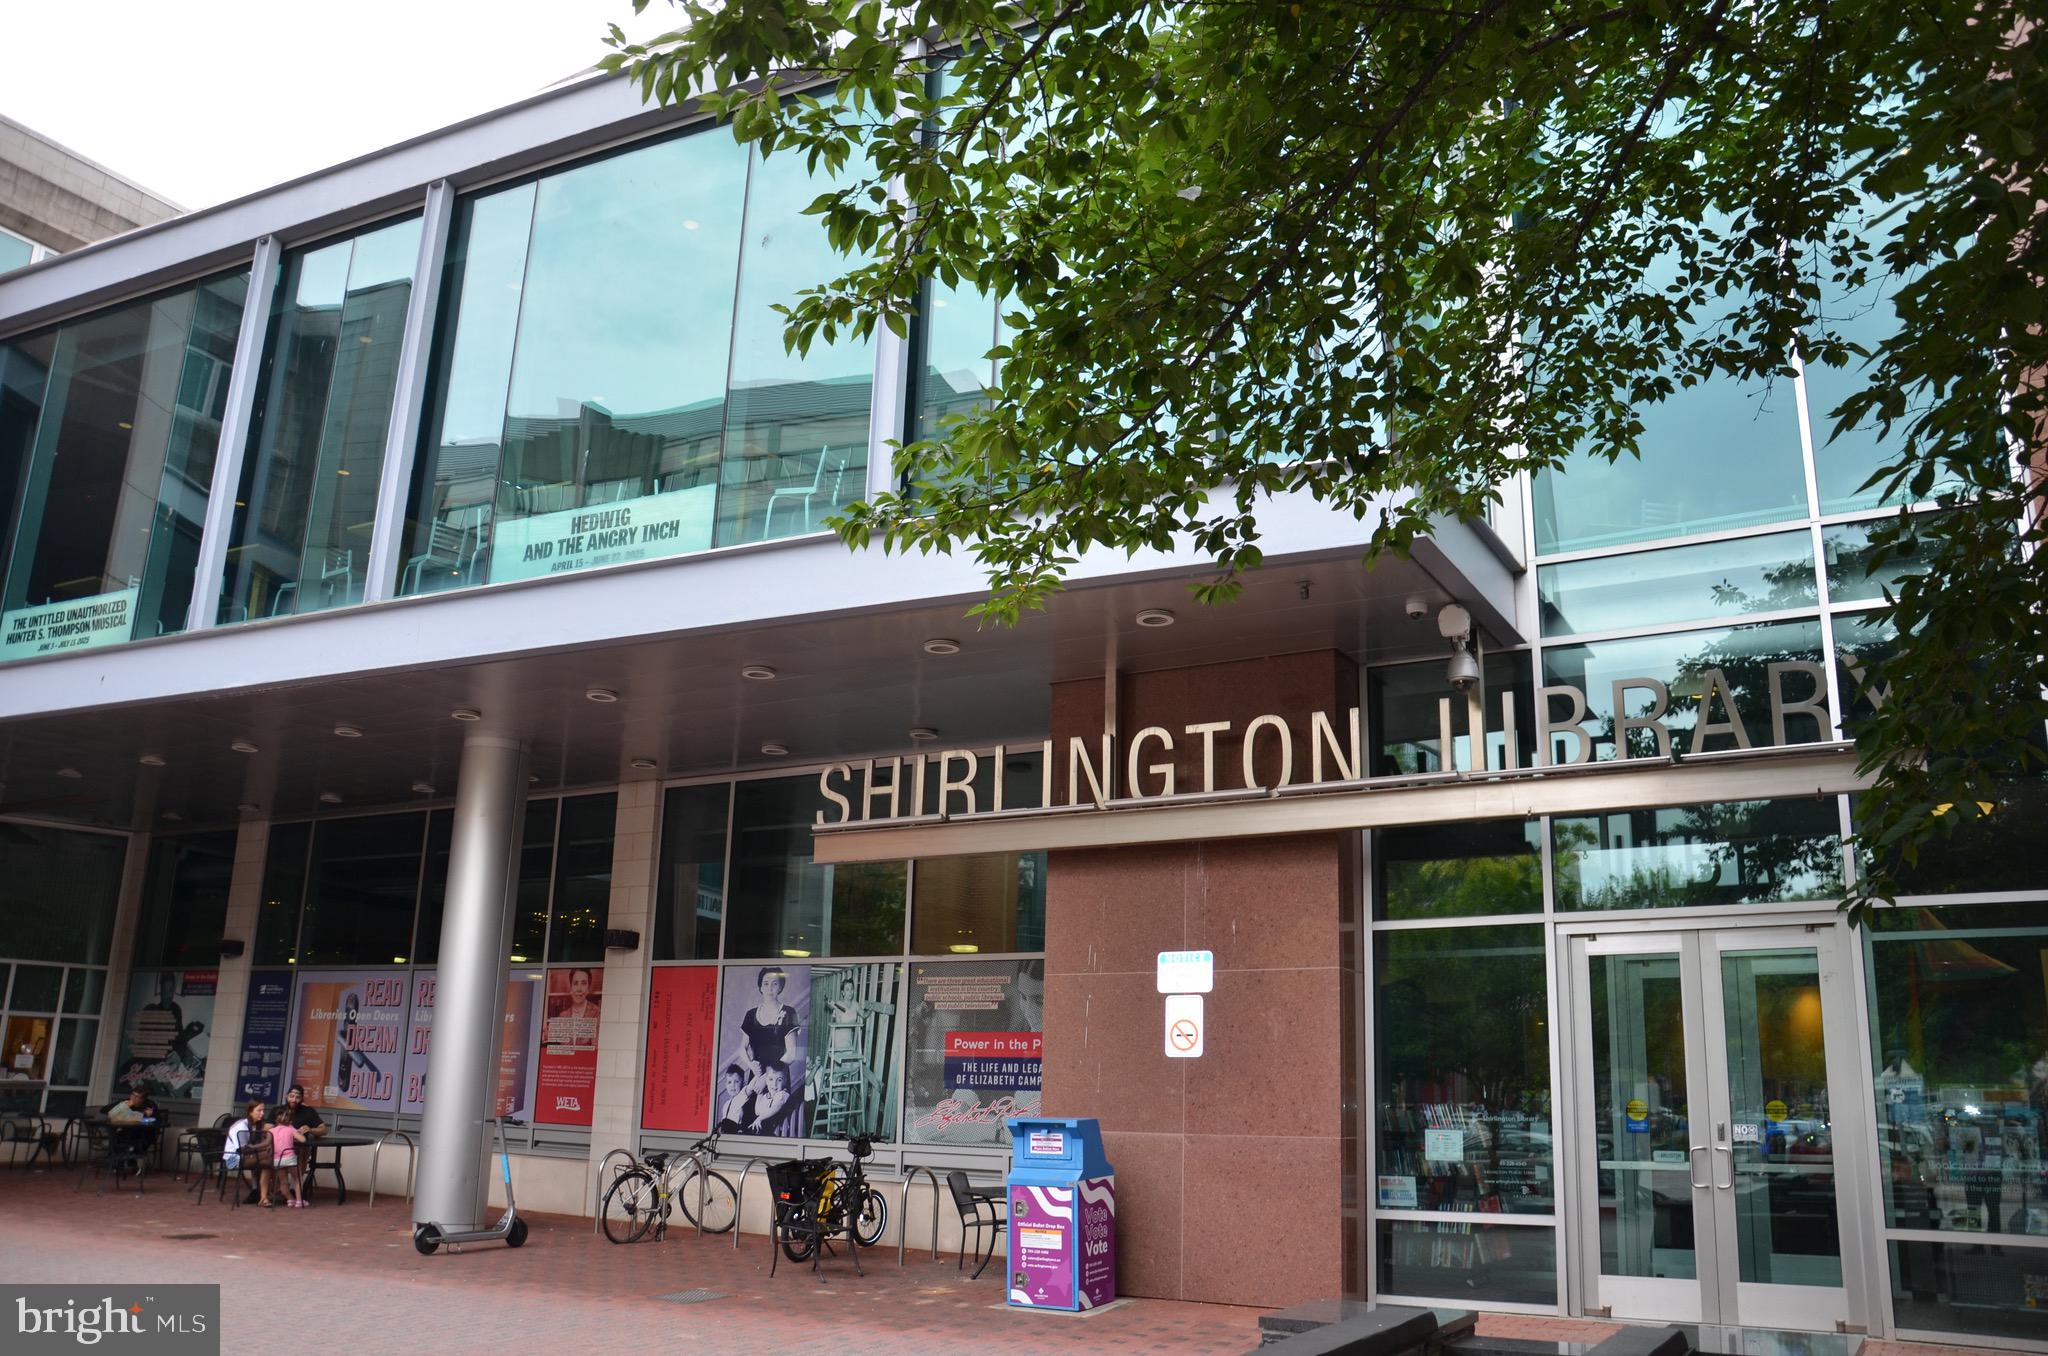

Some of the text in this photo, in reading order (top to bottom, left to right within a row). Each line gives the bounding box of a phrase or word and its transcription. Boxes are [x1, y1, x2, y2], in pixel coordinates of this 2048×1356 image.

[571, 508, 631, 534] HEDWIG
[522, 519, 681, 562] AND THE ANGRY INCH
[551, 561, 573, 572] APRIL
[13, 599, 127, 631] THE UNTITLED UNAUTHORIZED
[6, 614, 127, 645] HUNTER S. THOMPSON MUSICAL
[816, 707, 1361, 826] SHIRLINGTON
[364, 978, 404, 1007] READ
[311, 1008, 400, 1022] Libraries Open Doors
[346, 1024, 399, 1054] DREAM
[954, 1038, 990, 1049] Power
[994, 1038, 1005, 1049] in
[1009, 1038, 1028, 1050] the
[962, 1062, 978, 1073] THE
[981, 1062, 999, 1073] LIFE
[1002, 1063, 1019, 1073] AND
[349, 1071, 394, 1101] BUILD
[956, 1074, 967, 1085] OF
[969, 1074, 1015, 1086] ELIZABETH
[556, 1096, 580, 1109] WETA
[1085, 1206, 1108, 1225] Vote
[1085, 1222, 1108, 1241] Vote
[1086, 1239, 1108, 1257] Vote
